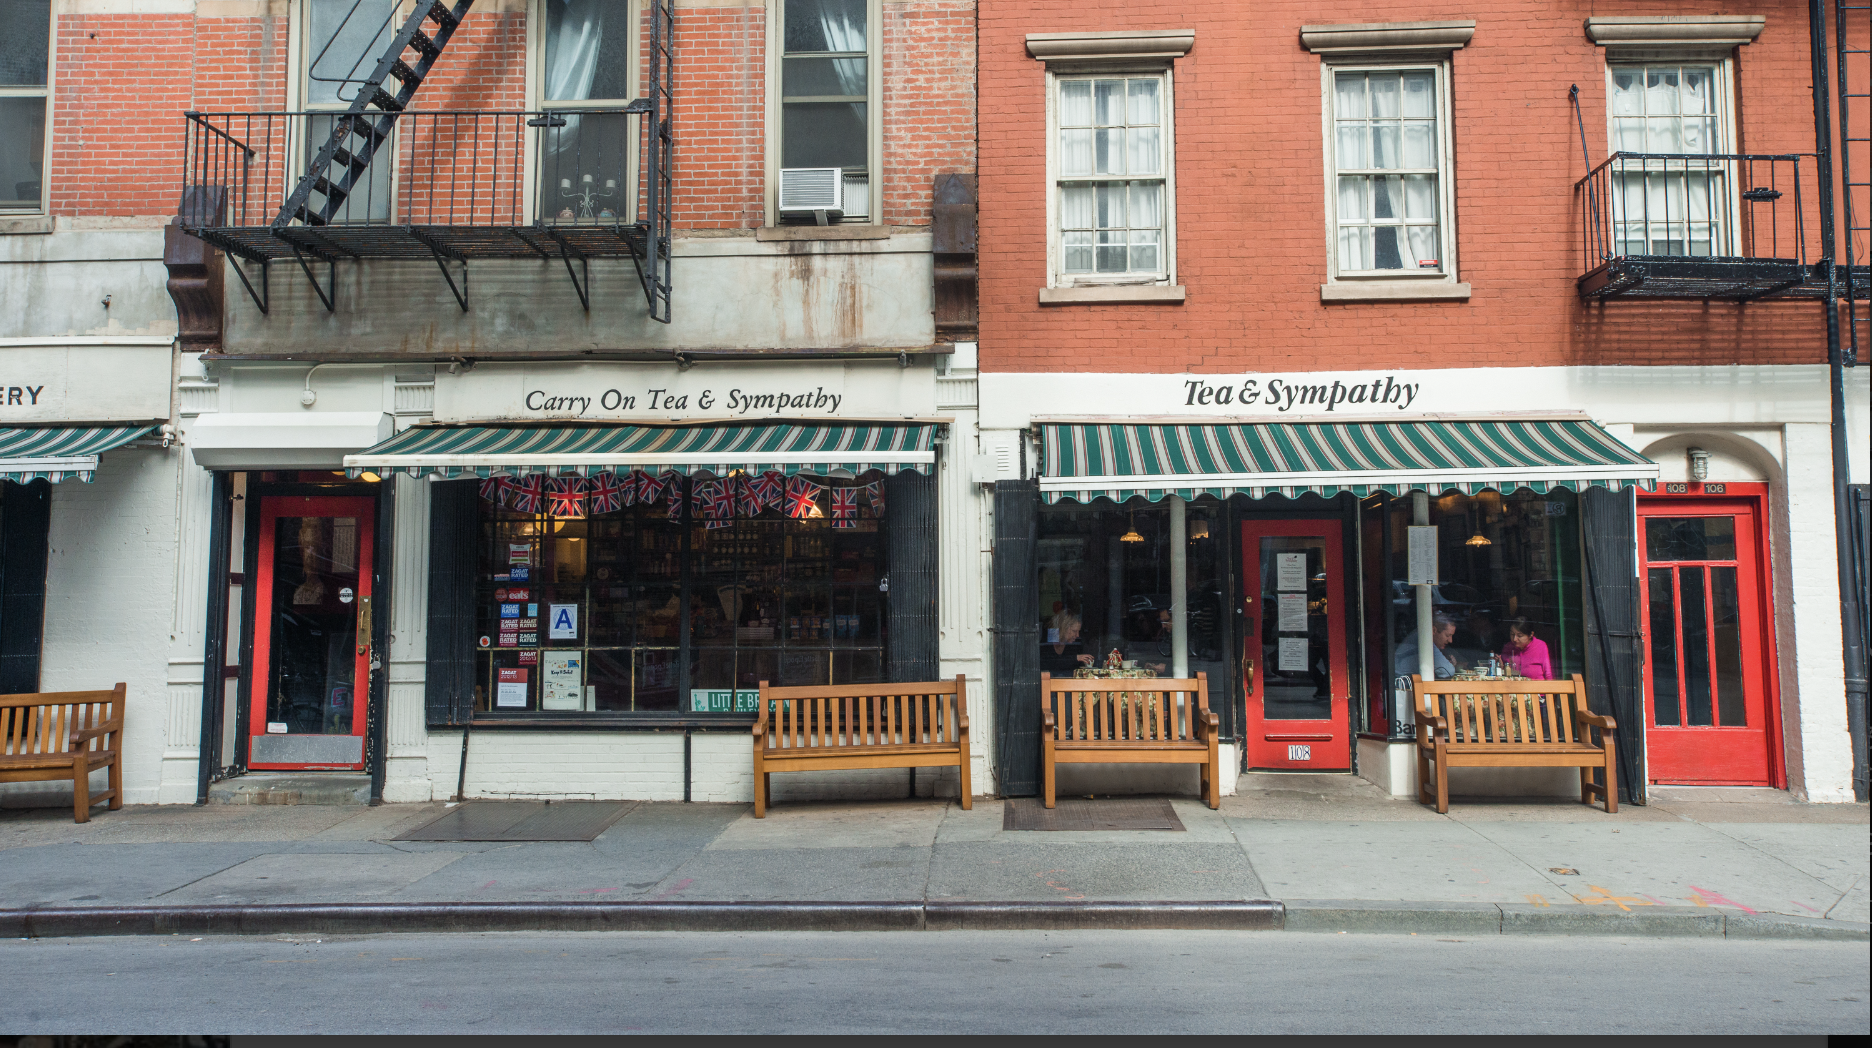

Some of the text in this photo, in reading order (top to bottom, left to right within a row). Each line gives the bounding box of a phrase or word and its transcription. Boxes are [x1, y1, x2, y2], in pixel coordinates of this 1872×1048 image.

[525, 386, 842, 415] Carry On Tea & Sympathy
[1667, 484, 1686, 493] 108
[1706, 484, 1724, 493] 106
[509, 589, 529, 600] eats
[554, 608, 573, 630] A
[712, 693, 743, 708] LITTE
[1290, 745, 1311, 760] 108
